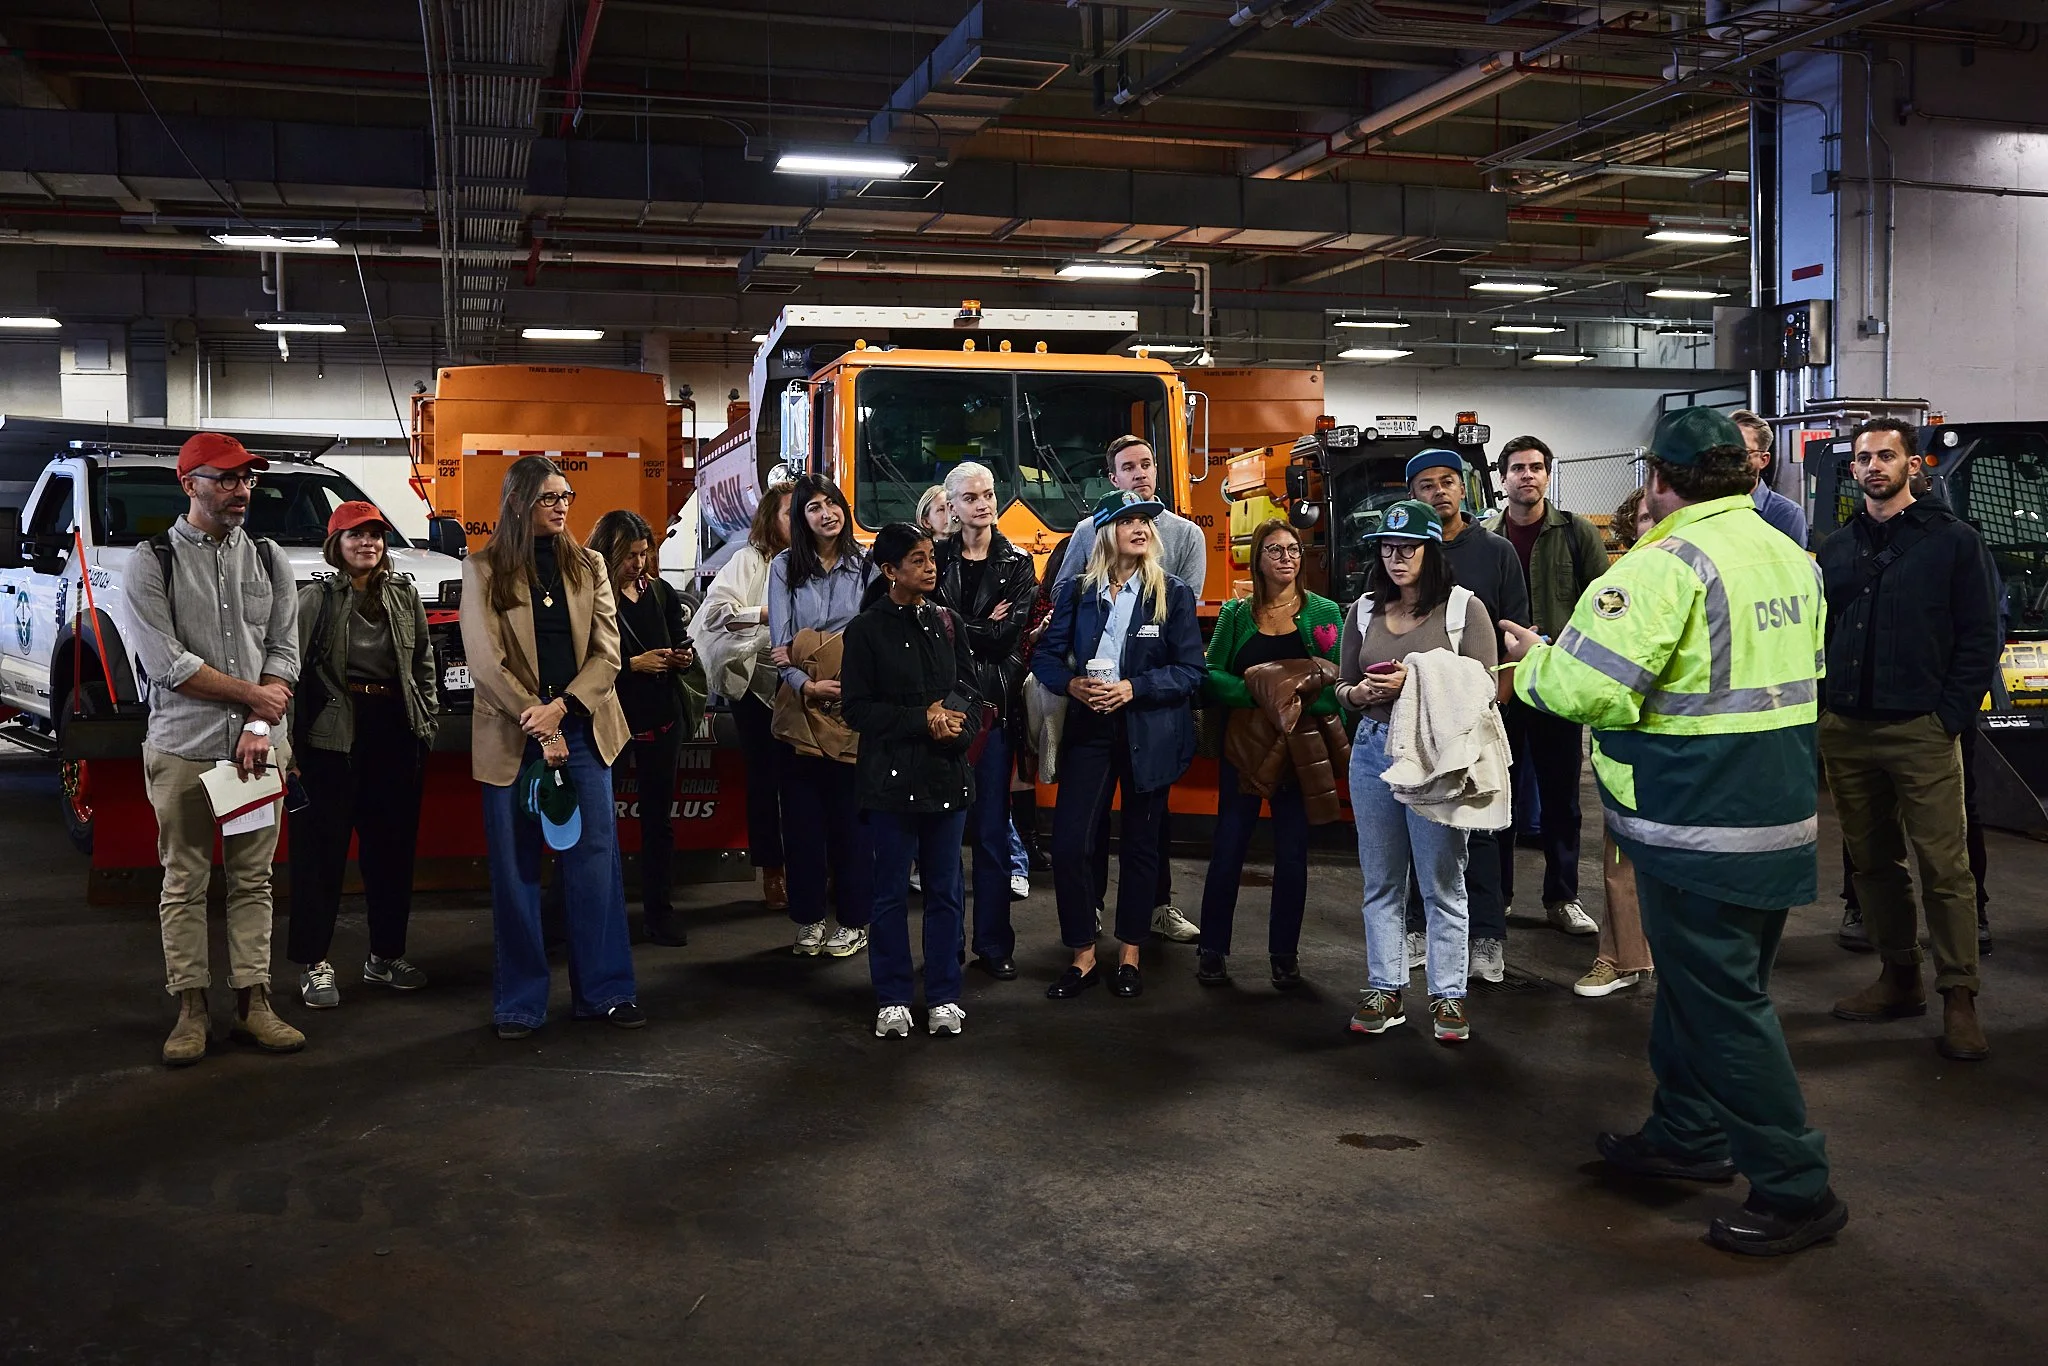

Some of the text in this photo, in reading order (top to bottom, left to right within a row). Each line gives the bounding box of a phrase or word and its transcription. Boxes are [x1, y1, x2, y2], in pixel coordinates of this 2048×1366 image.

[1986, 715, 2031, 728] EDGE
[680, 778, 721, 794] GRADE
[670, 801, 717, 818] LUS
